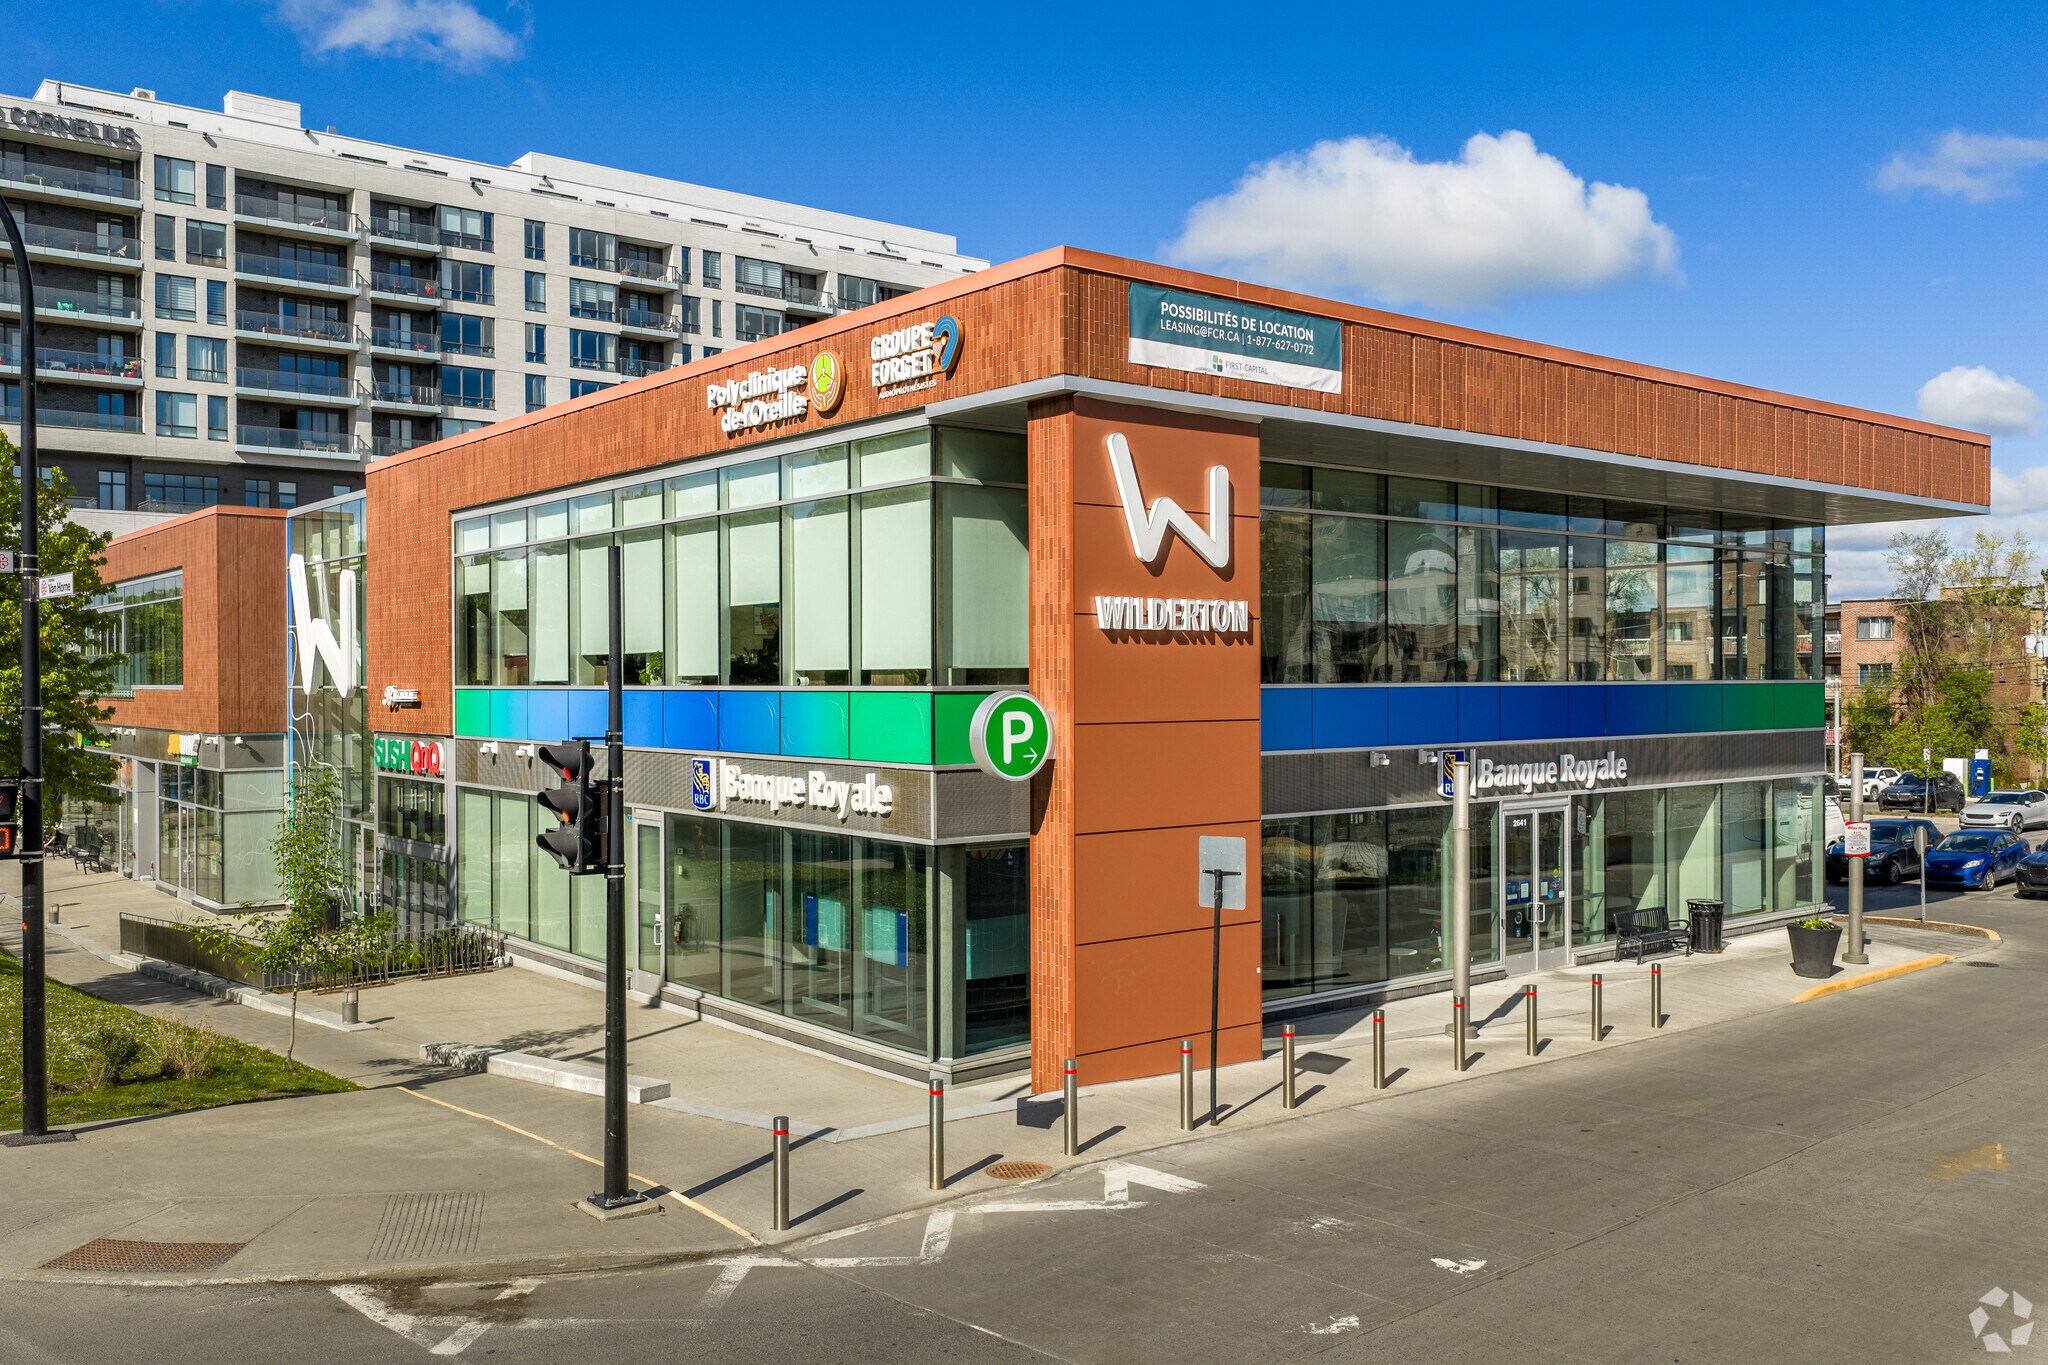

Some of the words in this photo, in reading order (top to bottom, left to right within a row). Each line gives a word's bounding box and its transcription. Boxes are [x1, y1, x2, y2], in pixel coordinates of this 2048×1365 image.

[10, 107, 135, 145] CORNELIUS
[1160, 302, 1238, 328] POSSIBILITÉS
[1241, 316, 1257, 331] DE
[1259, 320, 1314, 342] LOCATION
[1160, 319, 1240, 343] LEASING@FCR.CA
[1246, 335, 1315, 355] 1-877-627-0772
[871, 322, 934, 361] GROUPE
[707, 365, 807, 409] Polyclinique
[871, 349, 934, 387] FORGET
[1225, 361, 1243, 371] FIRST
[1244, 364, 1268, 375] CAPITAL
[721, 407, 744, 432] de
[1106, 432, 1229, 568] W
[48, 583, 57, 593] Van
[57, 582, 71, 592] Horne
[1095, 596, 1249, 632] WILDERTON
[1002, 711, 1034, 765] P
[1477, 758, 1558, 794] Banque
[1560, 750, 1628, 791] Royale
[694, 793, 709, 805] RBC
[725, 764, 806, 812] Banque
[808, 770, 893, 820] Royale
[1512, 819, 1527, 827] 2641
